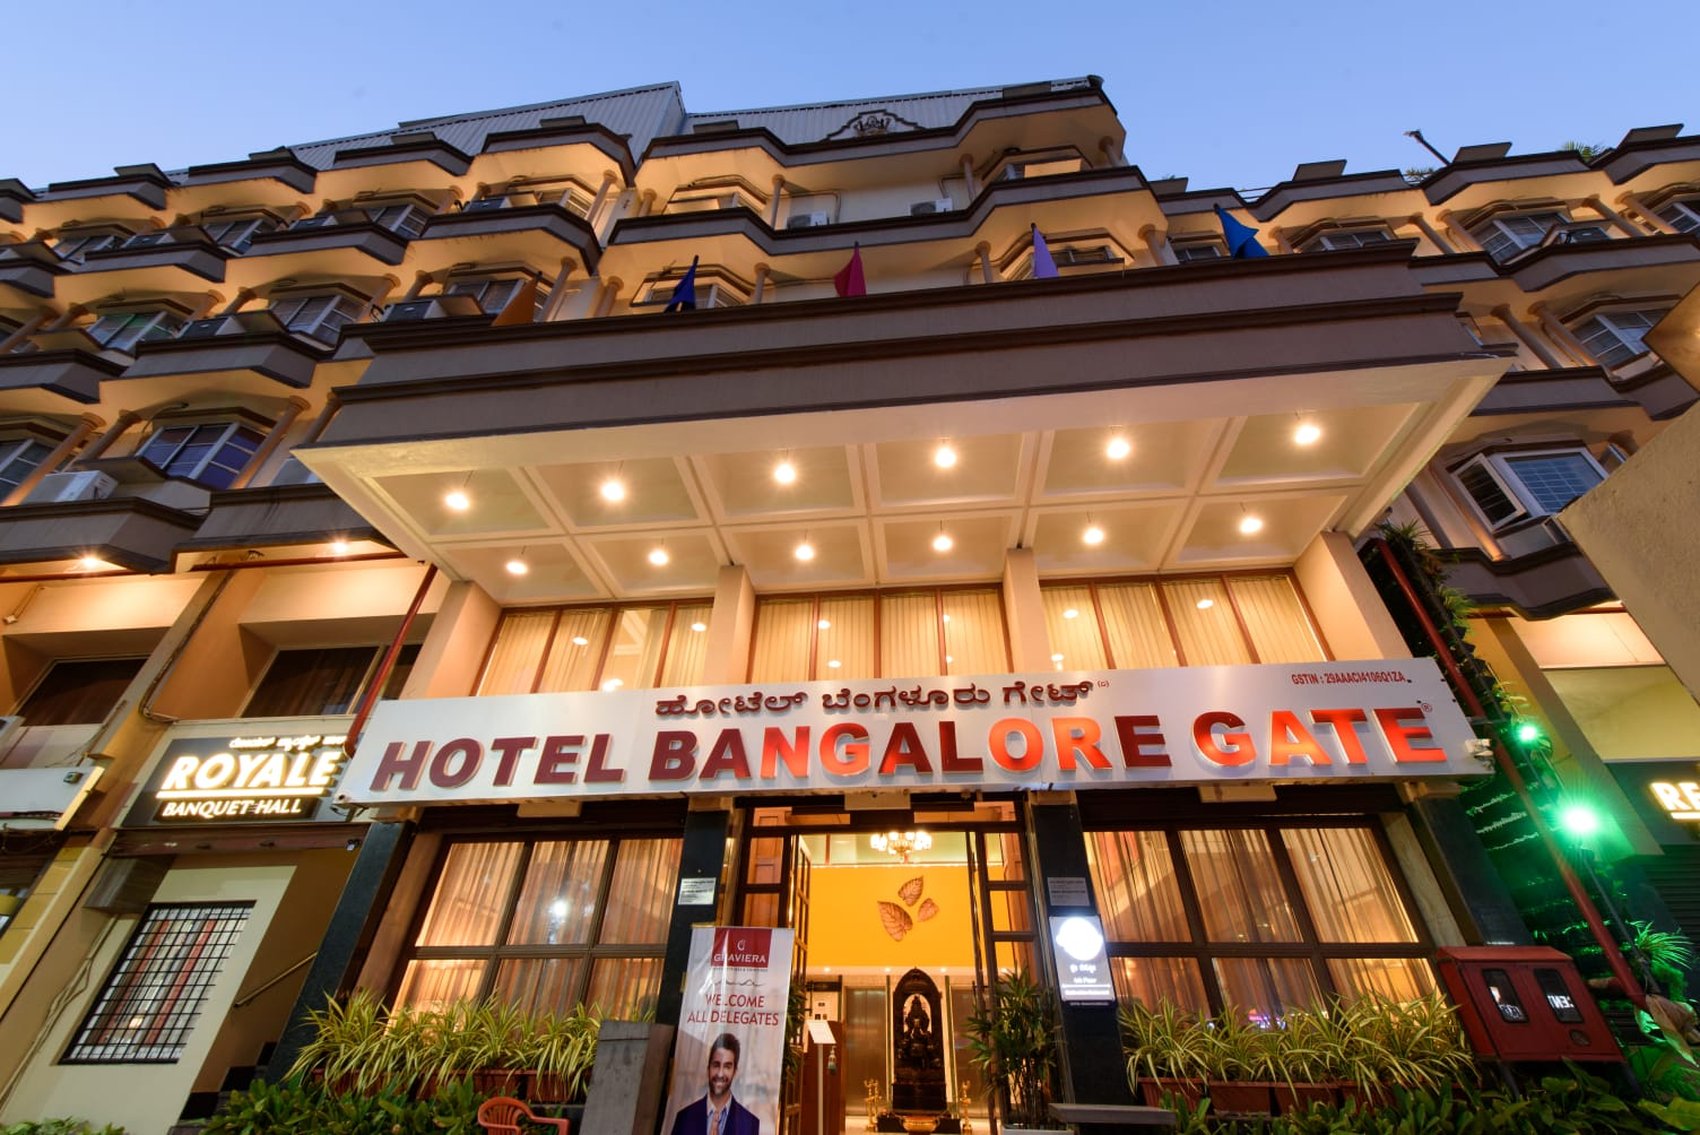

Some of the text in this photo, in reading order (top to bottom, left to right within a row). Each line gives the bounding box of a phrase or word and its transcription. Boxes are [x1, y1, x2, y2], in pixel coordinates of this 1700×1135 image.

[1291, 673, 1319, 685] GSTIN
[655, 679, 1093, 718] ಹೋಟೆಲ್ ಬೆಂಗಳೂರು ಗೇಟ್
[369, 708, 1447, 792] HOTEL BANGALORE GATE
[160, 751, 343, 791] ROYALE
[162, 797, 302, 819] BANQUET HALL
[687, 1010, 779, 1026] ALL DELEGATES
